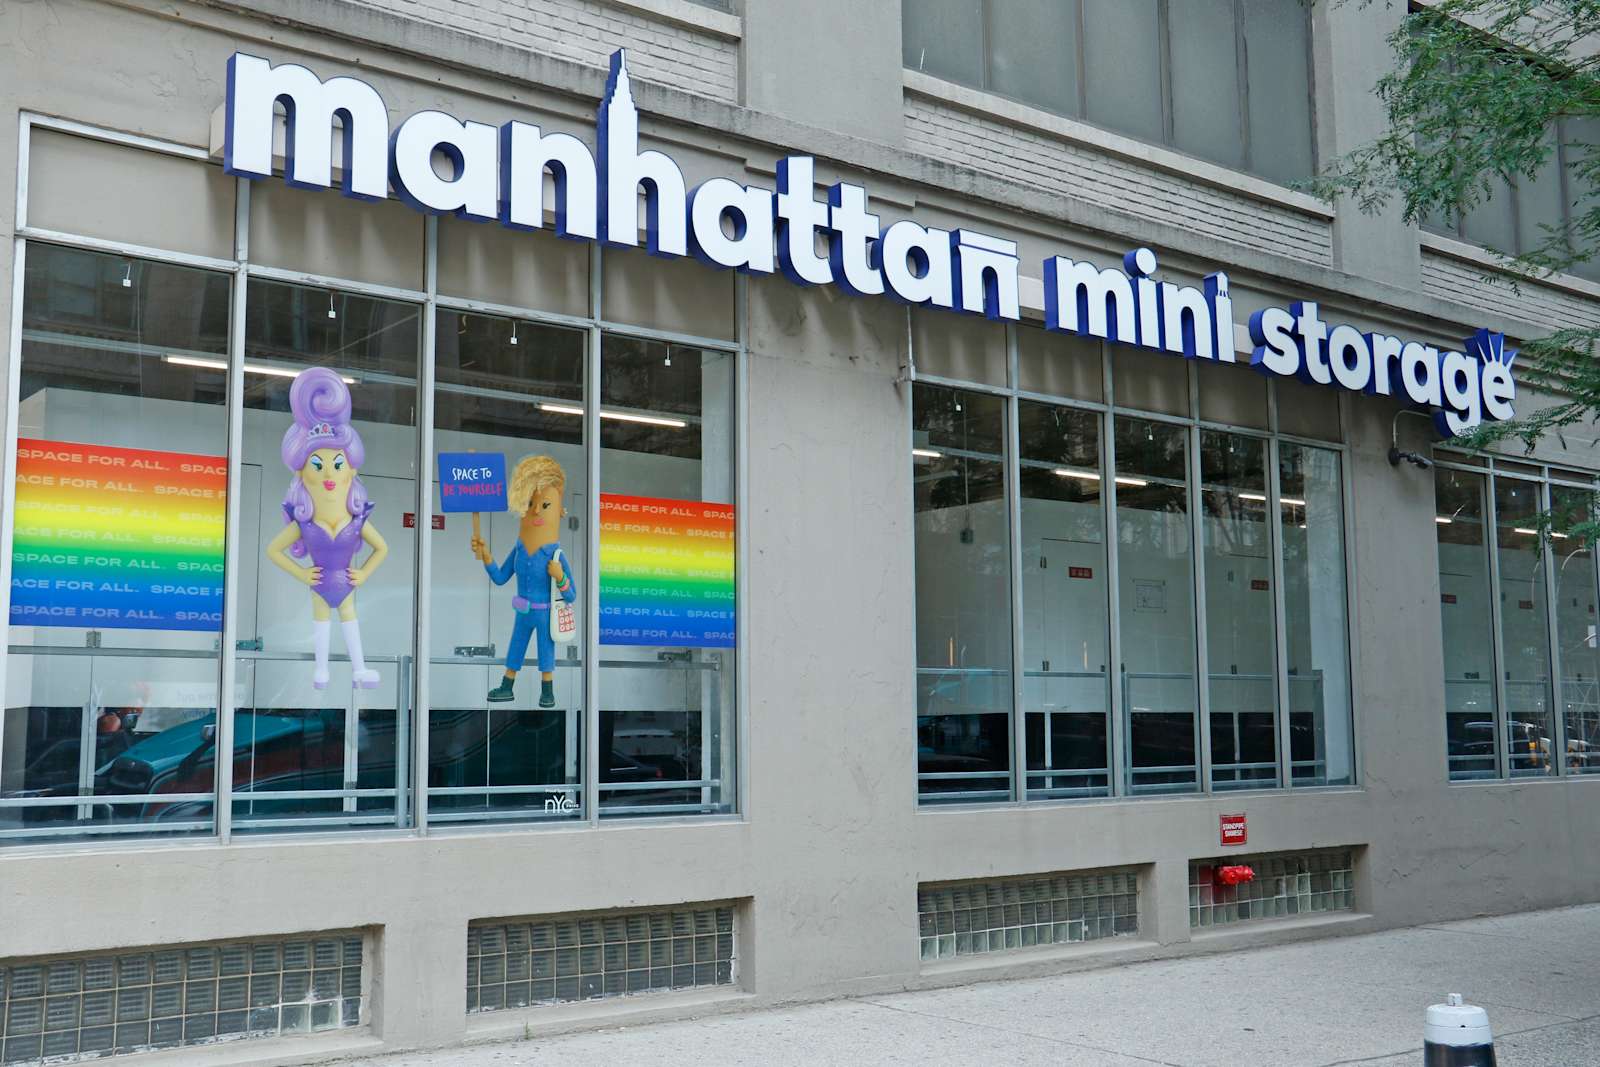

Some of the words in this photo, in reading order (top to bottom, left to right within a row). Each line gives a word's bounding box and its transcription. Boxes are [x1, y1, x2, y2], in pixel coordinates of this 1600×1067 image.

[227, 48, 1021, 320] manhattan
[1044, 247, 1236, 362] mini
[1250, 300, 1518, 437] storage
[16, 449, 83, 463] SPACE
[88, 455, 126, 467] FOR
[452, 467, 479, 481] SPACE
[60, 477, 98, 489] FOR
[154, 484, 214, 499] SPACE
[457, 480, 503, 497] YOURSELF
[15, 500, 81, 513] SPACE
[86, 505, 123, 516] FOR
[642, 505, 667, 514] FOR
[57, 529, 96, 540] FOR
[152, 535, 213, 547] SPACE
[624, 524, 649, 533] FOR
[687, 528, 726, 539] SPACE
[13, 552, 79, 565] SPACE
[84, 557, 121, 568] FOR
[55, 580, 94, 591] FOR
[151, 585, 210, 596] SPACE
[642, 588, 667, 597] FOR
[10, 605, 76, 617] SPACE
[81, 608, 120, 618] FOR
[624, 608, 650, 617] FOR
[687, 610, 727, 619] SPACE
[642, 629, 667, 639] FOR
